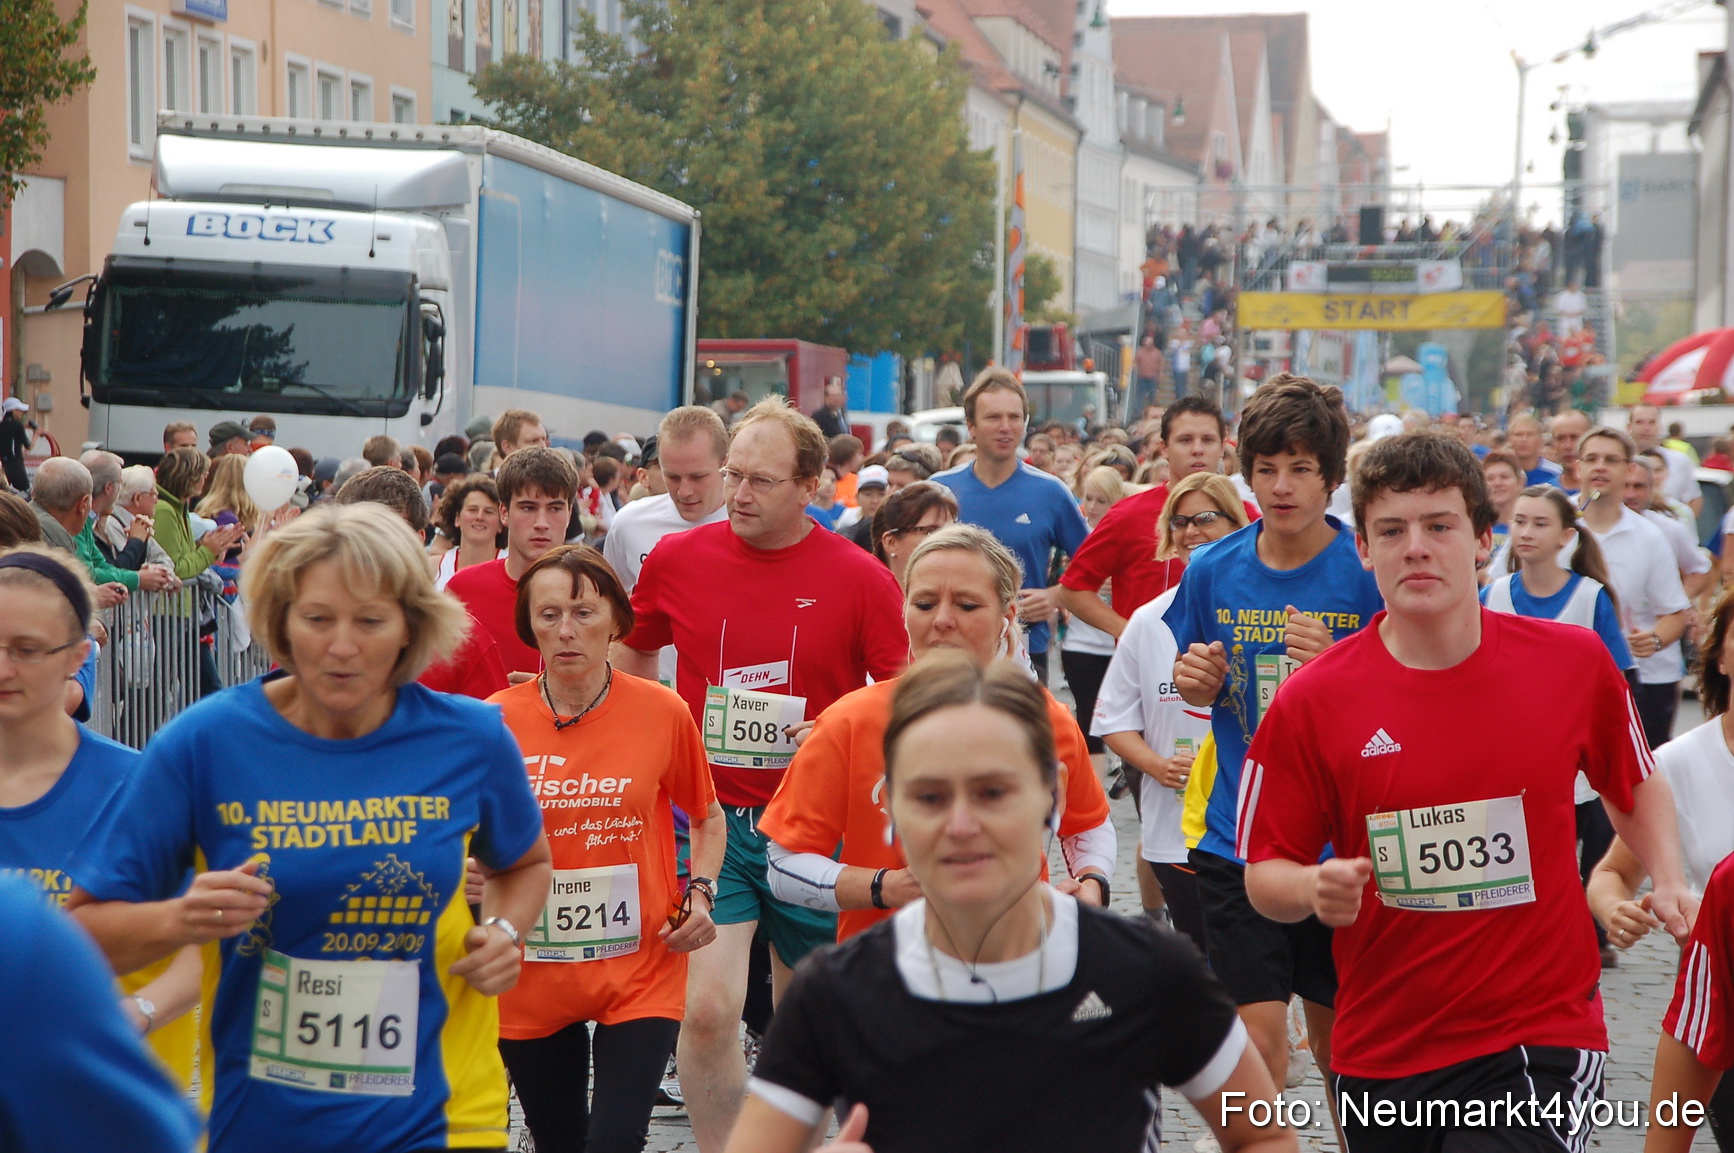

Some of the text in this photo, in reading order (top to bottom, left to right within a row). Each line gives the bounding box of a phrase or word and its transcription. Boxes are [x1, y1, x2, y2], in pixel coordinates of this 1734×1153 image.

[186, 211, 336, 244] BOCK
[1323, 299, 1413, 322] START
[1216, 608, 1235, 625] 10.
[740, 670, 770, 684] DEHN
[1262, 687, 1269, 700] S
[732, 694, 769, 712] Xaver
[708, 715, 715, 727] S
[732, 719, 792, 745] 5081
[1361, 742, 1402, 757] adidas
[216, 796, 450, 825] 10. NEUMARKTER
[540, 797, 622, 810] UTOMOBILE
[1409, 807, 1466, 829] Lukas
[252, 820, 418, 849] STADTLAUF
[553, 822, 578, 837] und
[580, 818, 603, 831] das
[1378, 846, 1389, 862] S
[1419, 832, 1515, 875] 5033
[553, 877, 592, 895] Irene
[1474, 883, 1531, 901] PFLEIDERER
[556, 901, 631, 932] 5214
[322, 932, 426, 953] 20.09.2009
[596, 941, 639, 954] PFLEIDERER
[297, 970, 344, 996] Resi
[262, 999, 272, 1018] S
[1072, 1005, 1113, 1022] adidas
[298, 1011, 403, 1050] 5116
[348, 1073, 411, 1086] PFLEIDERER
